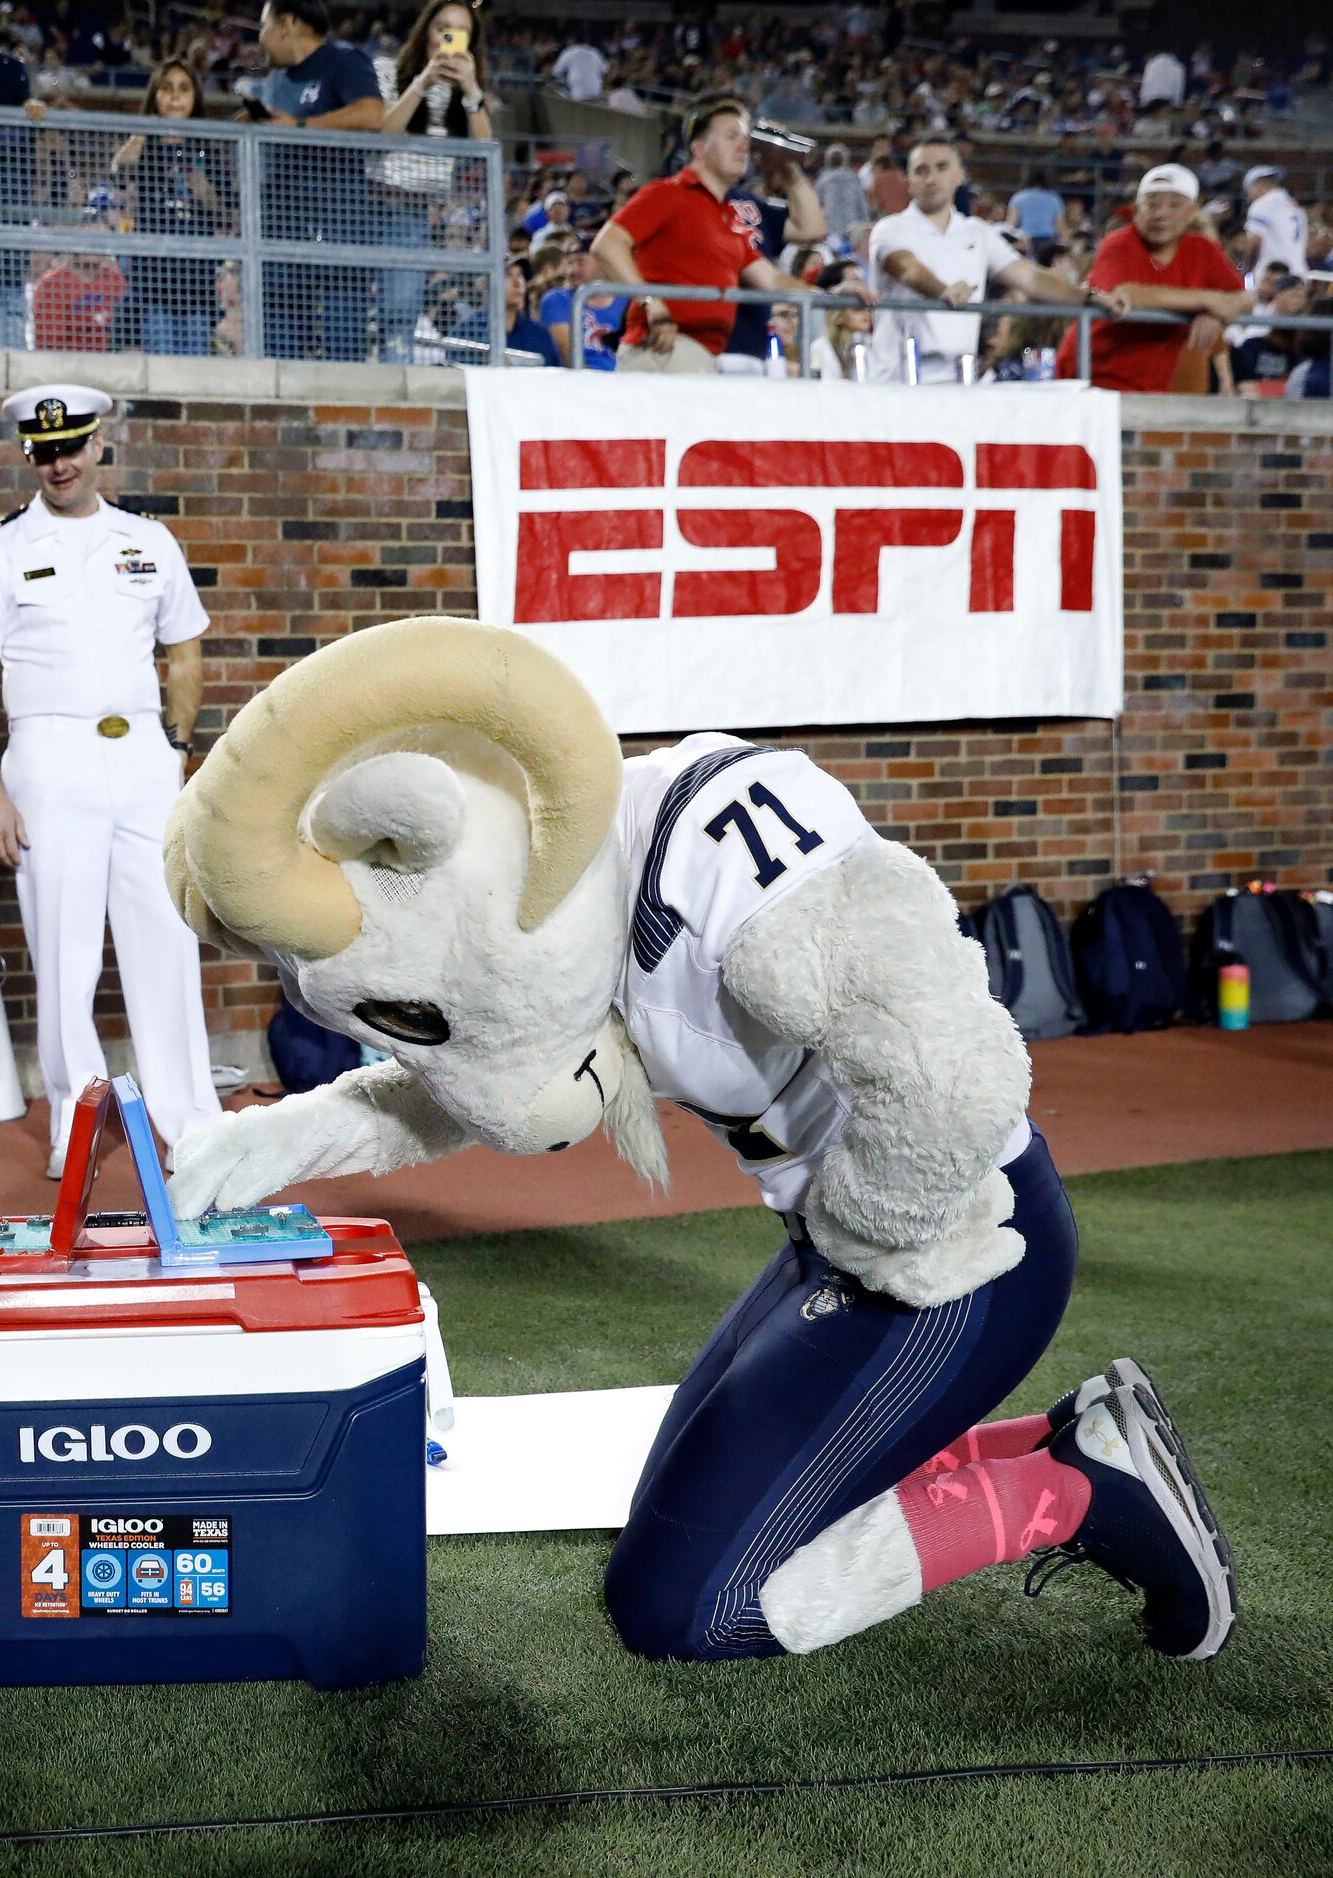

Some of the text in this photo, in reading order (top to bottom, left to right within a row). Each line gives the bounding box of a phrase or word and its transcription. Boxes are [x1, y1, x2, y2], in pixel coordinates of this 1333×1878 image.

[513, 438, 1097, 625] ESPN
[701, 779, 828, 892] 71
[19, 1423, 212, 1463] IGLOO
[91, 1519, 164, 1533] IGLOO
[193, 1521, 228, 1529] MADE IN
[193, 1529, 228, 1537] TEXAS
[31, 1549, 69, 1590] 4
[176, 1553, 212, 1573] 60
[180, 1583, 193, 1595] 94
[201, 1582, 225, 1596] 56
[34, 1592, 67, 1601] DAYS
